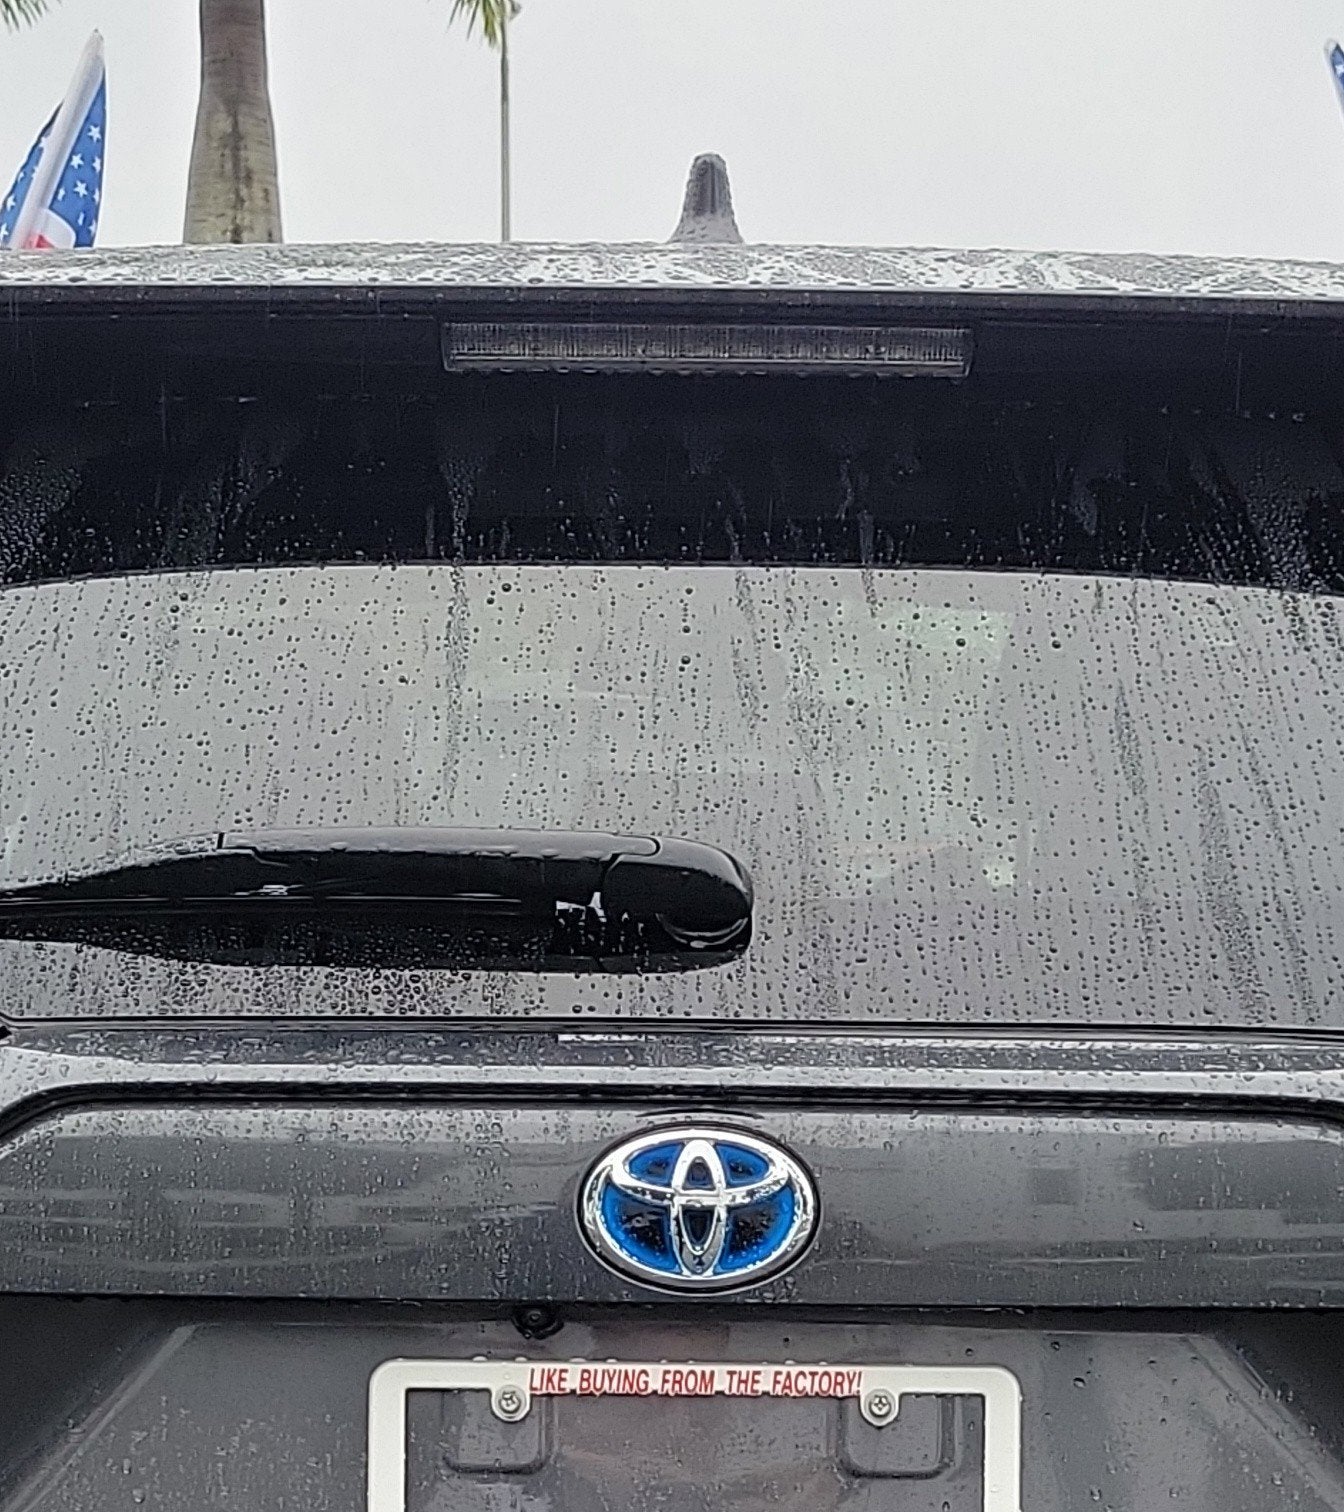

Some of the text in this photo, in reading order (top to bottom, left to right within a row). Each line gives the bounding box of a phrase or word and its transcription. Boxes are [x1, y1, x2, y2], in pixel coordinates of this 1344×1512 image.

[529, 1368, 863, 1396] LIKE BUYING FROM THE FACTORY!
